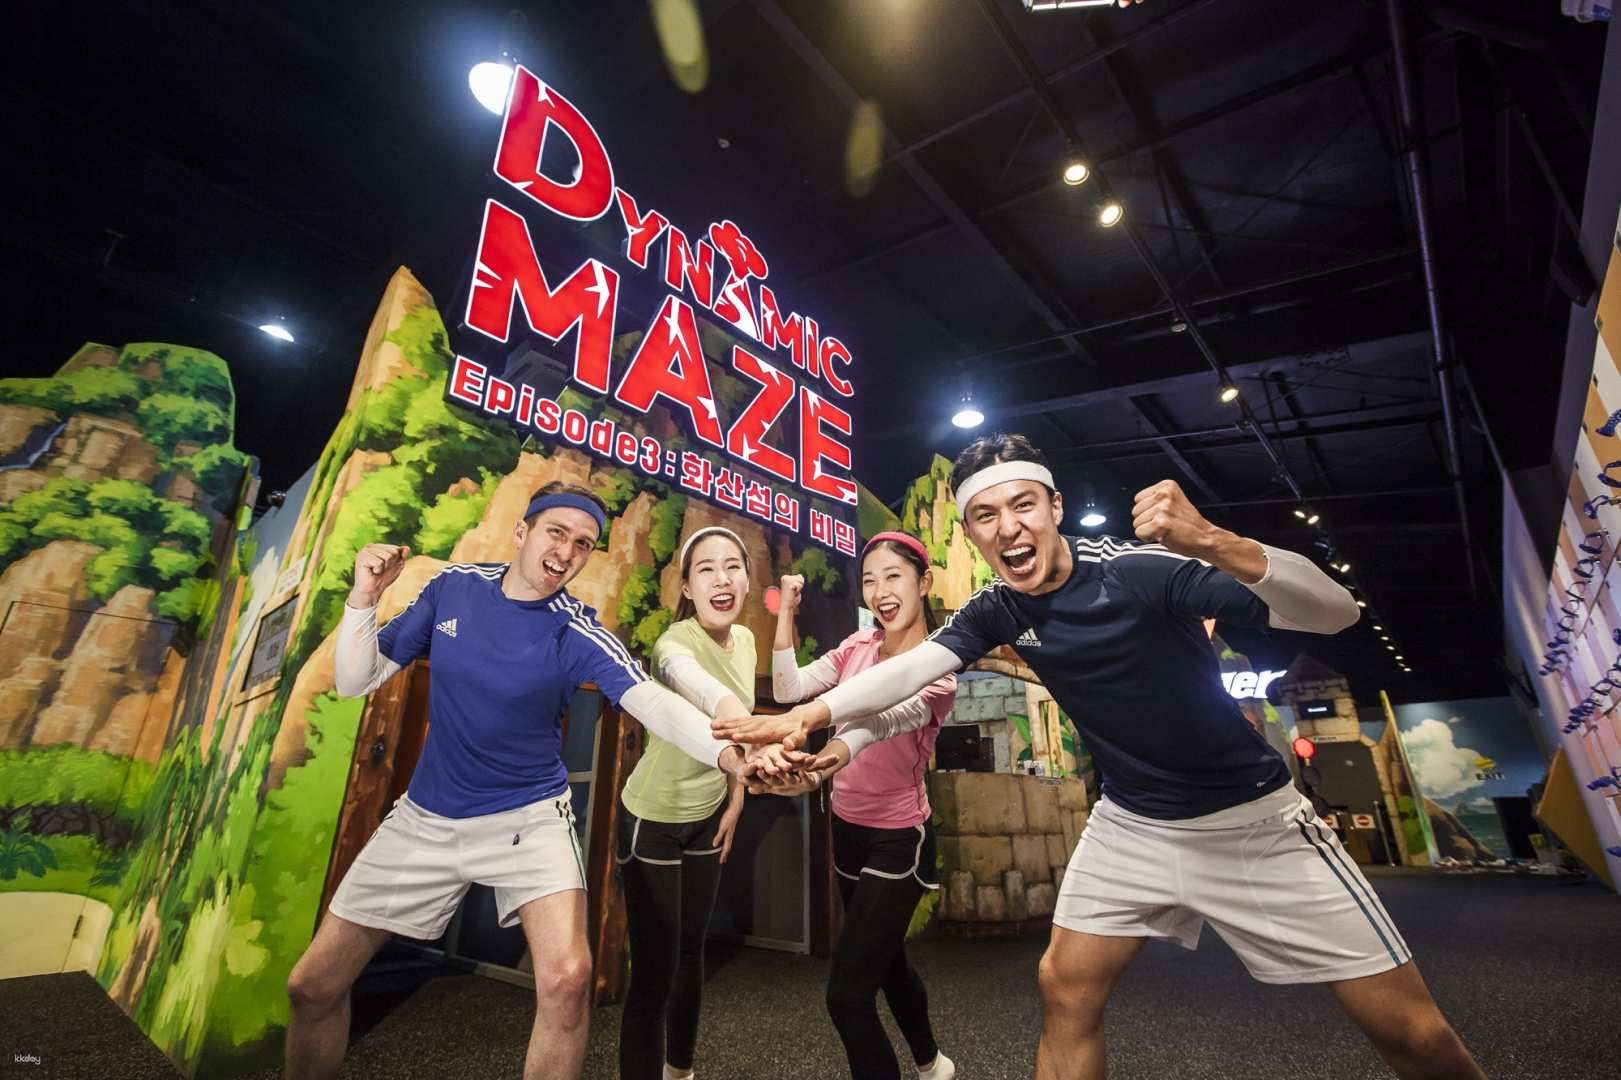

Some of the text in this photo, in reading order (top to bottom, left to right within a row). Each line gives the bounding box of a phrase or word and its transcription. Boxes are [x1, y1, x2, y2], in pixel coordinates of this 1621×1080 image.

[494, 64, 854, 396] DYNAMIC
[465, 199, 858, 505] MAZE
[810, 508, 856, 557] 비밀
[1015, 639, 1042, 647] adidas
